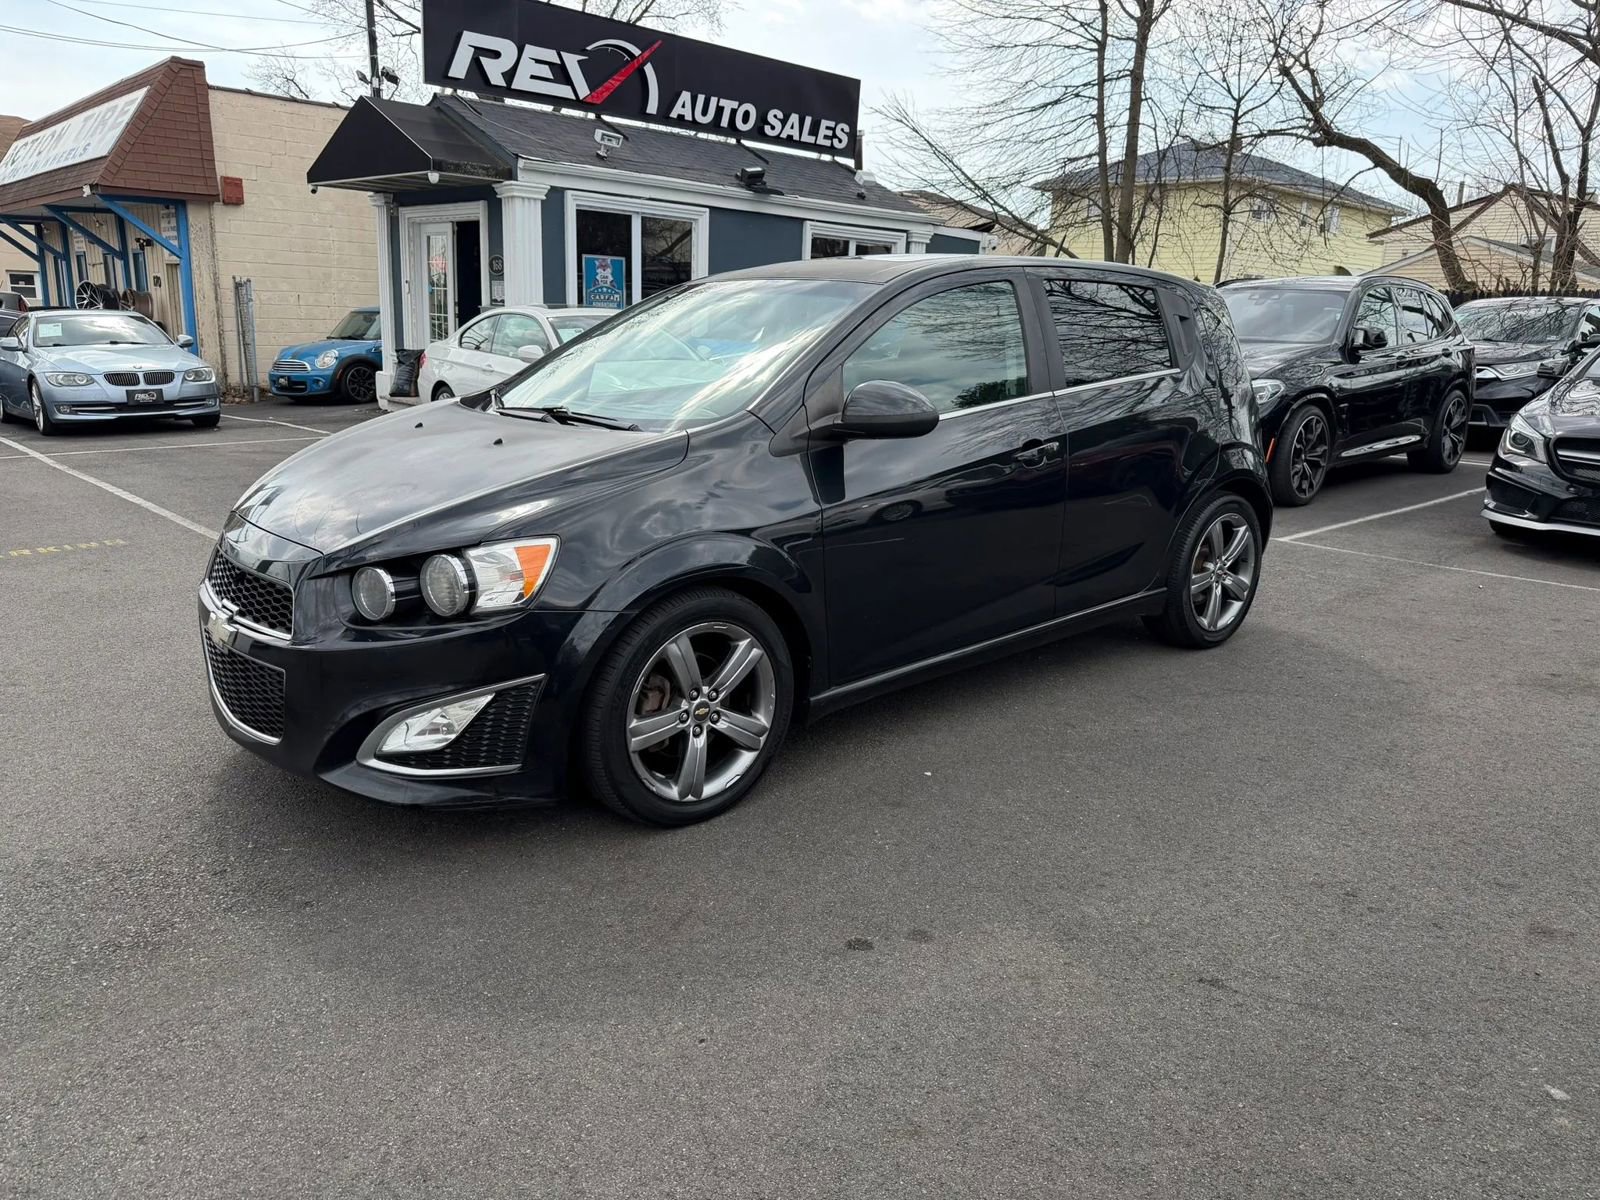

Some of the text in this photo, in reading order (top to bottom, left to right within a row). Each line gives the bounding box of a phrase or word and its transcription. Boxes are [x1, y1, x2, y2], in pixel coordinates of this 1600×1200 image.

[74, 96, 140, 142] TIRE
[448, 30, 850, 149] REV AUTO SALES
